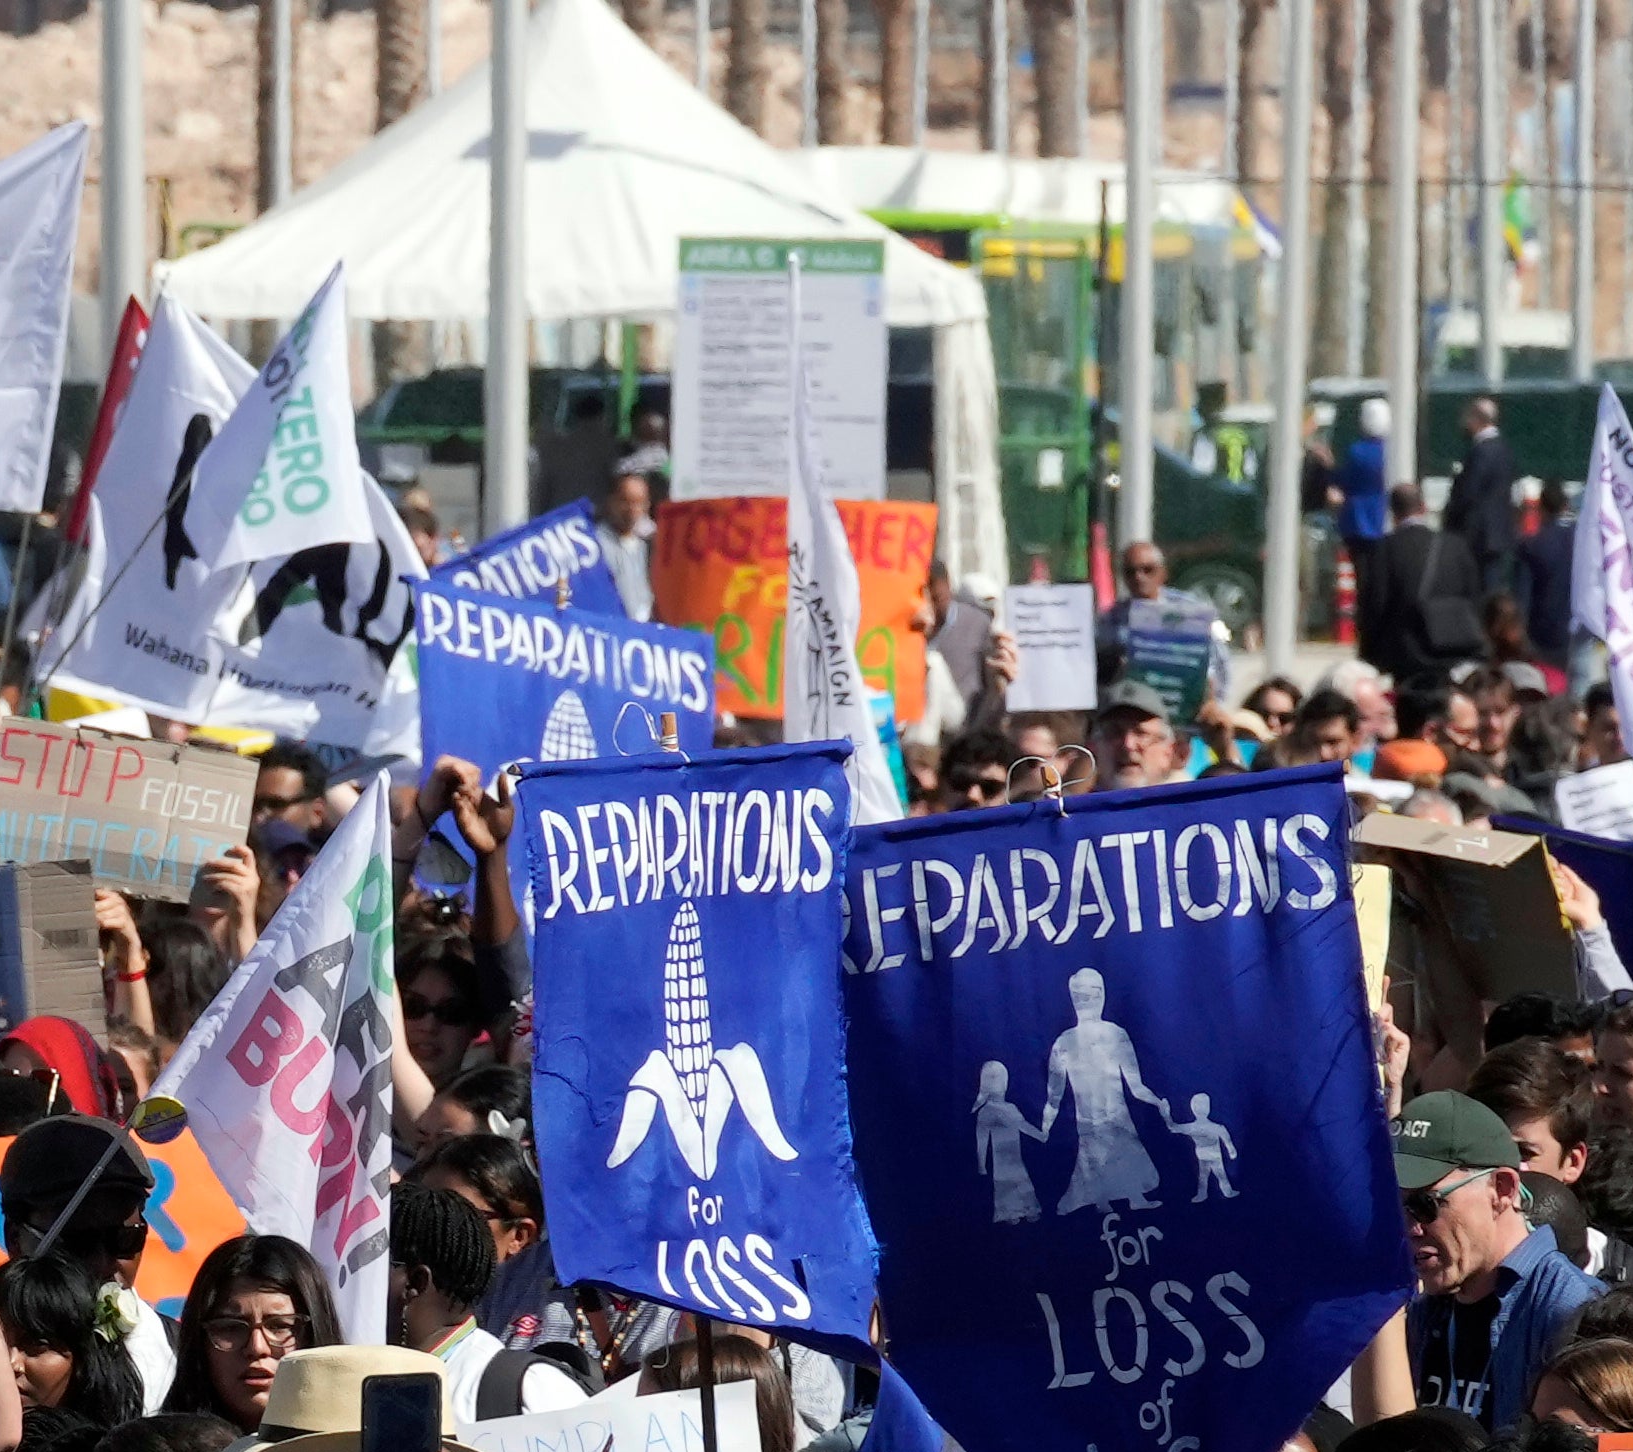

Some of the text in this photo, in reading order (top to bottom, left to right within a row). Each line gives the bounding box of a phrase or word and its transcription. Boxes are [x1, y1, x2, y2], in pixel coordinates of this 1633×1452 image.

[454, 517, 602, 597] ATIONS
[657, 502, 932, 572] TOGEHER
[124, 622, 210, 676] Wahana
[418, 591, 710, 714] REPARATIONS
[138, 776, 248, 831] FOSSIL
[538, 787, 837, 919] REPARATIONS
[1403, 1119, 1431, 1139] ACT
[687, 1185, 724, 1225] for
[658, 1232, 812, 1322] LOSS
[1099, 1212, 1164, 1282] for
[1037, 1271, 1269, 1391] LOSS
[1139, 1379, 1176, 1446] of
